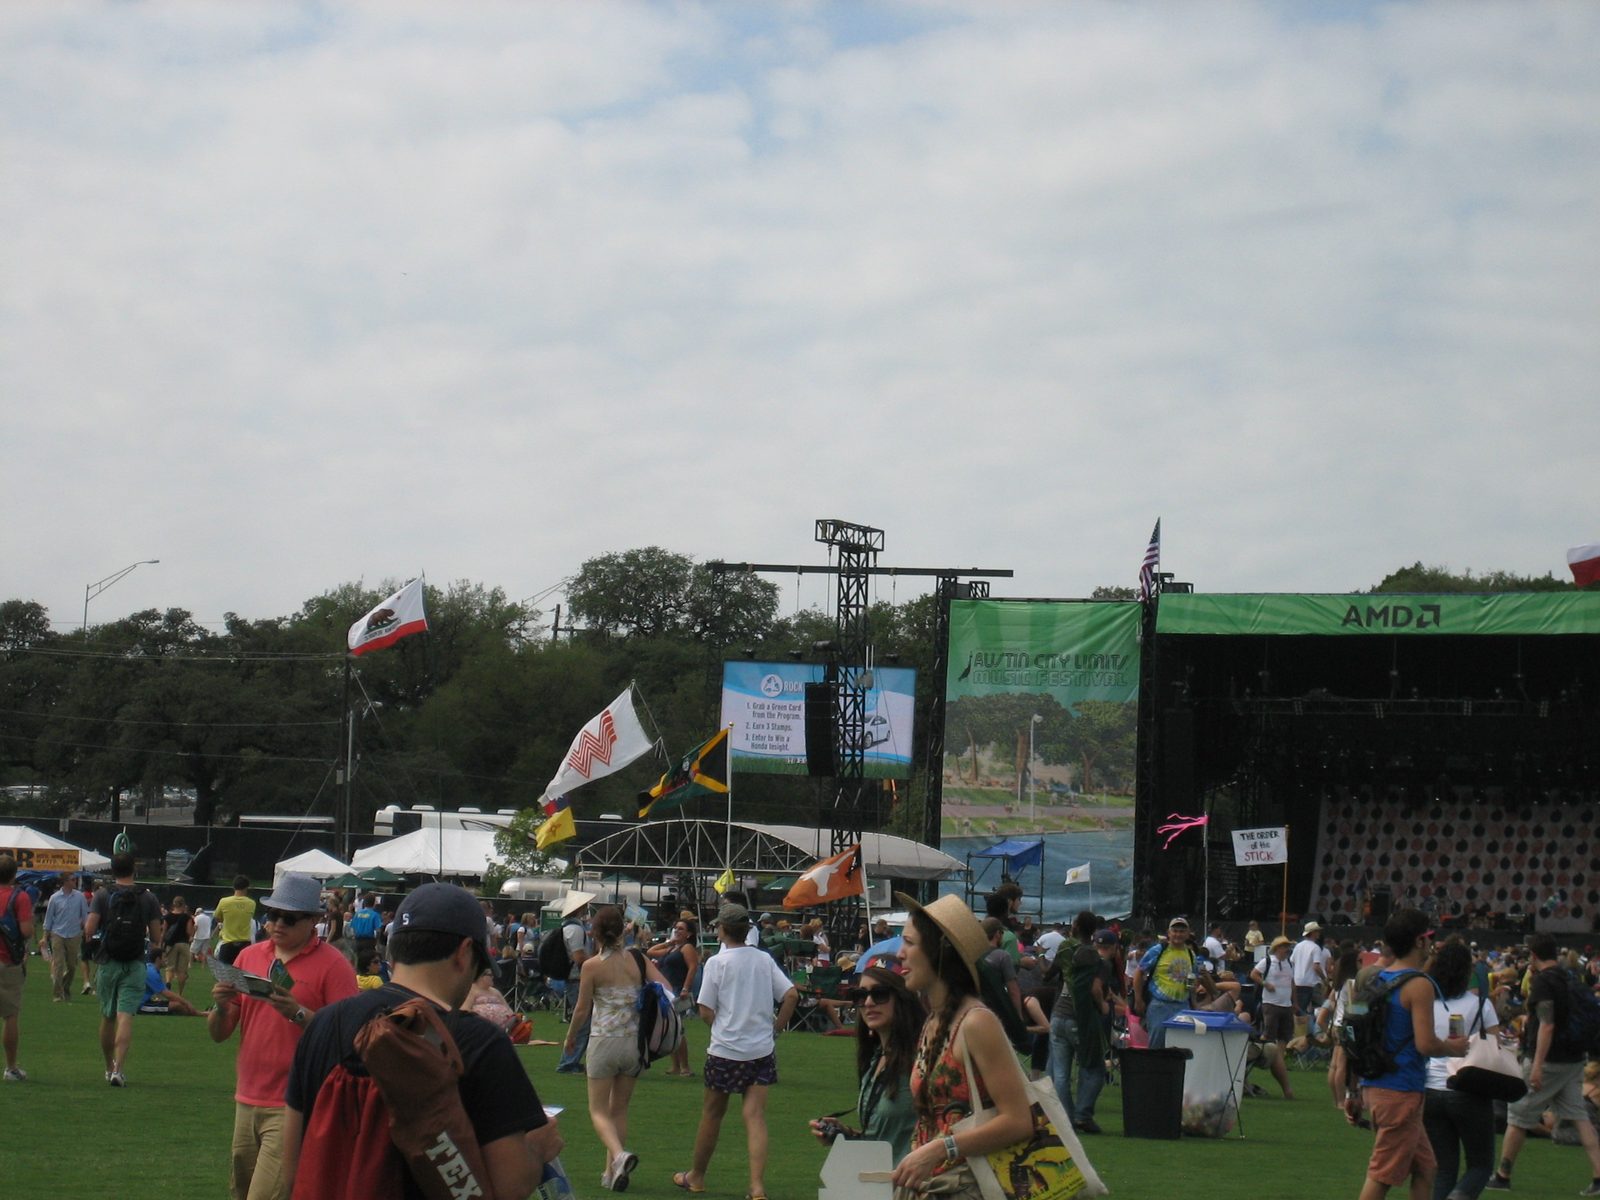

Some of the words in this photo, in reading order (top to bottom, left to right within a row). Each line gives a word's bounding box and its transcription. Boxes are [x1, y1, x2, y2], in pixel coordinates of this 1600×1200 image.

[1341, 604, 1413, 628] AMD
[973, 652, 1030, 668] AUSTIN
[1034, 653, 1070, 668] CITY
[1074, 653, 1129, 671] LIMITS
[973, 670, 1030, 686] MUSIC
[1034, 670, 1128, 687] FESTIVAL
[752, 702, 765, 711] Grab
[771, 703, 787, 711] Green
[788, 703, 802, 711] Card
[752, 710, 765, 718] from
[767, 711, 776, 719] the
[1240, 832, 1255, 841] THE
[1257, 831, 1279, 840] ORDER
[1250, 841, 1258, 850] of
[1260, 841, 1270, 849] the
[1244, 851, 1273, 862] STICK
[402, 912, 410, 925] S
